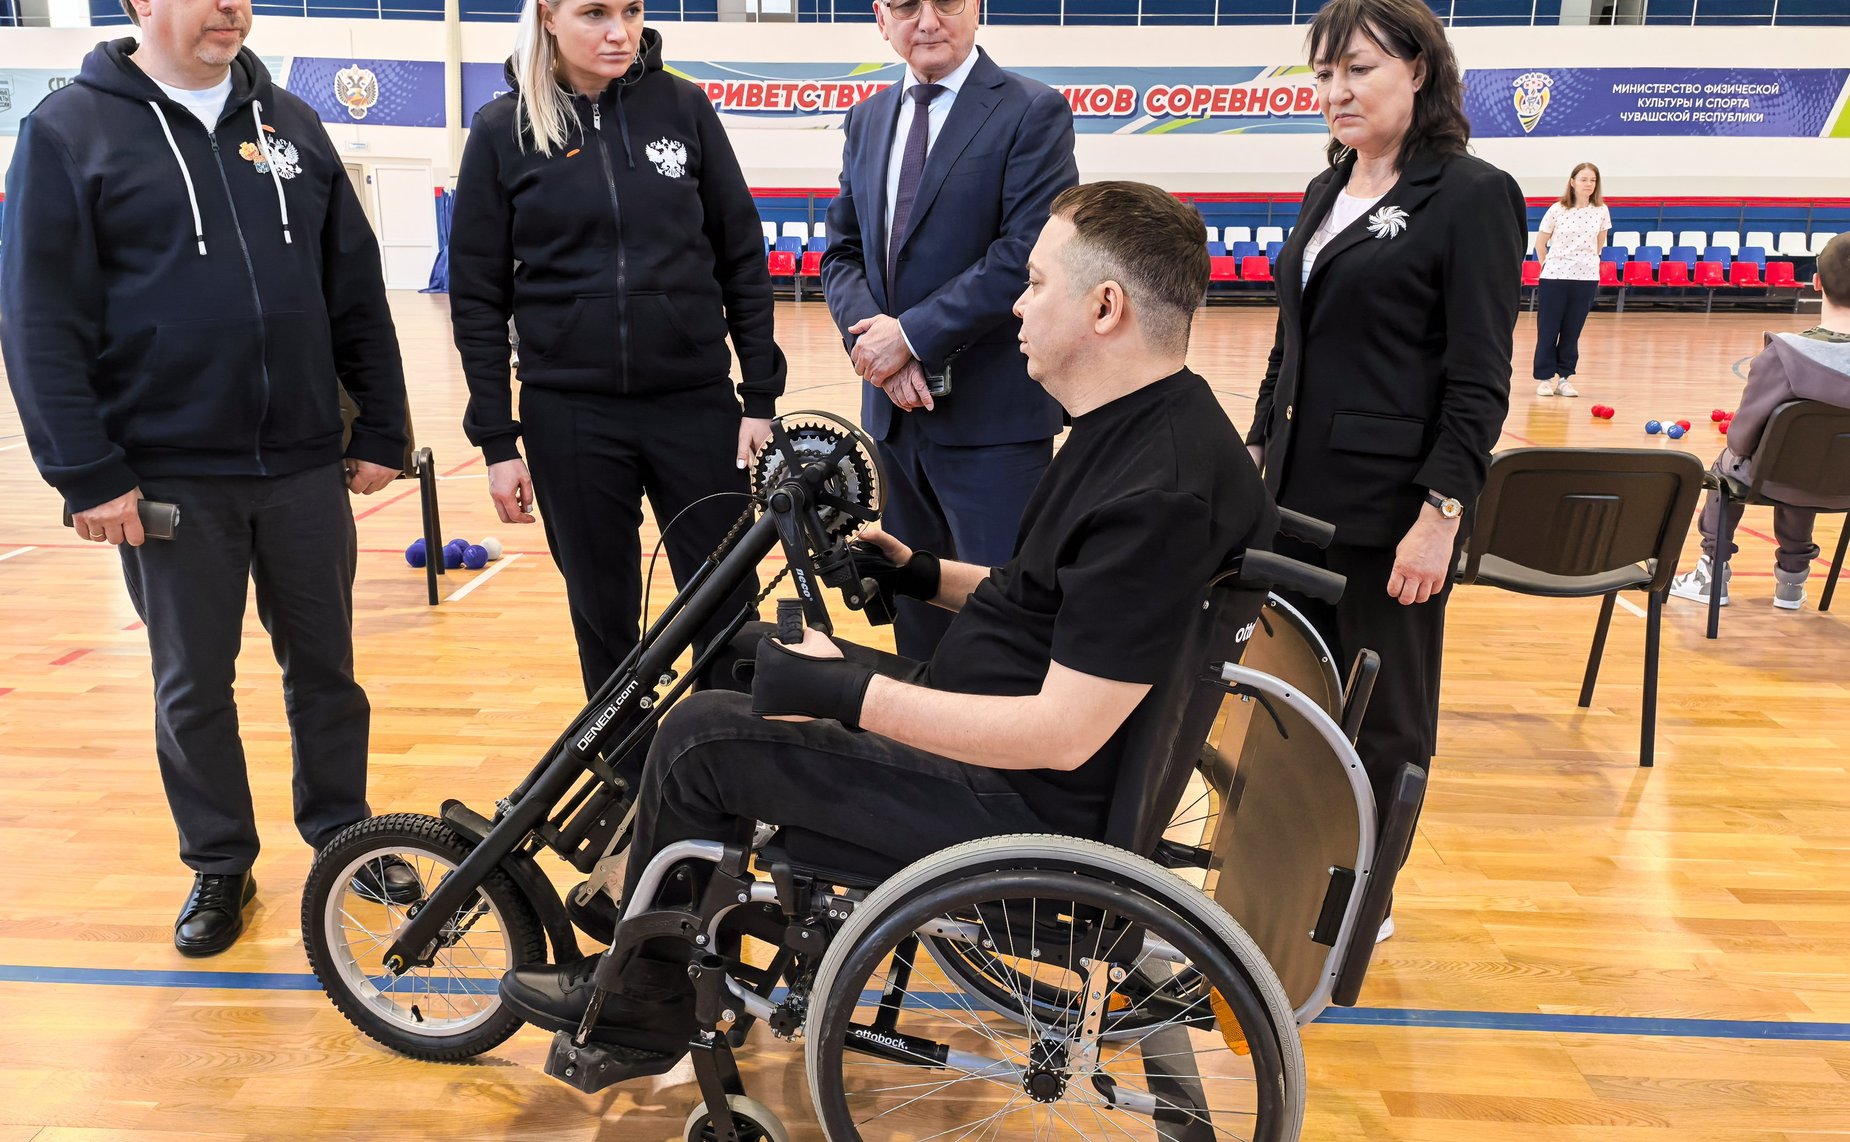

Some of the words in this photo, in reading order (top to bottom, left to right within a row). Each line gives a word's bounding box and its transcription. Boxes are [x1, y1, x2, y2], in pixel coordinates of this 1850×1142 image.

[1612, 83, 1701, 94] МИНИСТЕРСТВО
[1704, 83, 1779, 95] ФИЗИЧЕСКОЙ
[695, 83, 892, 109] РИВЕТСТВУ
[1637, 98, 1692, 108] КУЛЬТУРЫ
[1695, 98, 1703, 108] И
[1705, 98, 1750, 108] СПОРТА
[1620, 112, 1690, 122] ЧУВАШСКОЙ
[1692, 112, 1764, 123] РЕСПУБЛИКИ
[576, 680, 639, 751] DENEDi.com
